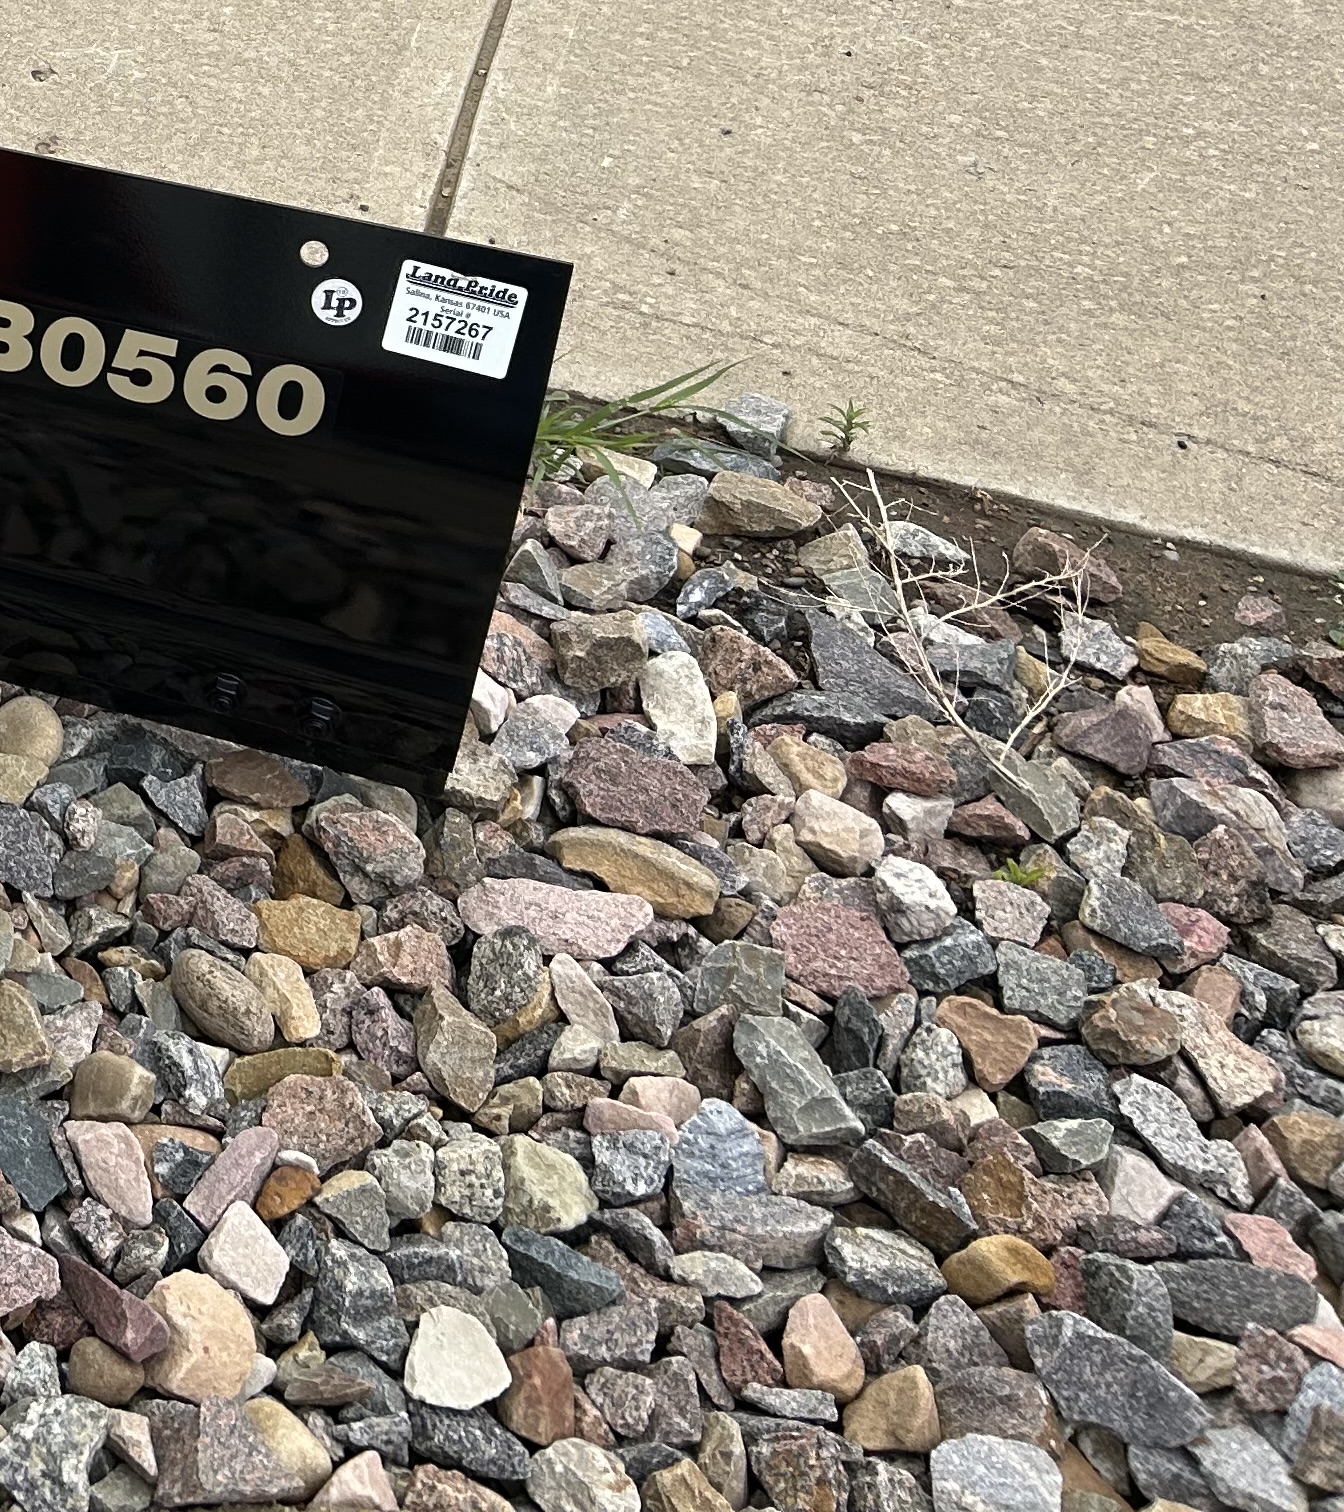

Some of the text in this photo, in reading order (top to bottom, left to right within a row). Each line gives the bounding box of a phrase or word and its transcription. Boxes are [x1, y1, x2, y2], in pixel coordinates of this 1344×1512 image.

[409, 265, 519, 306] Land Pride
[434, 293, 463, 308] Kansas
[493, 308, 511, 319] USA
[440, 305, 464, 317] Serial
[405, 307, 494, 341] 2157267
